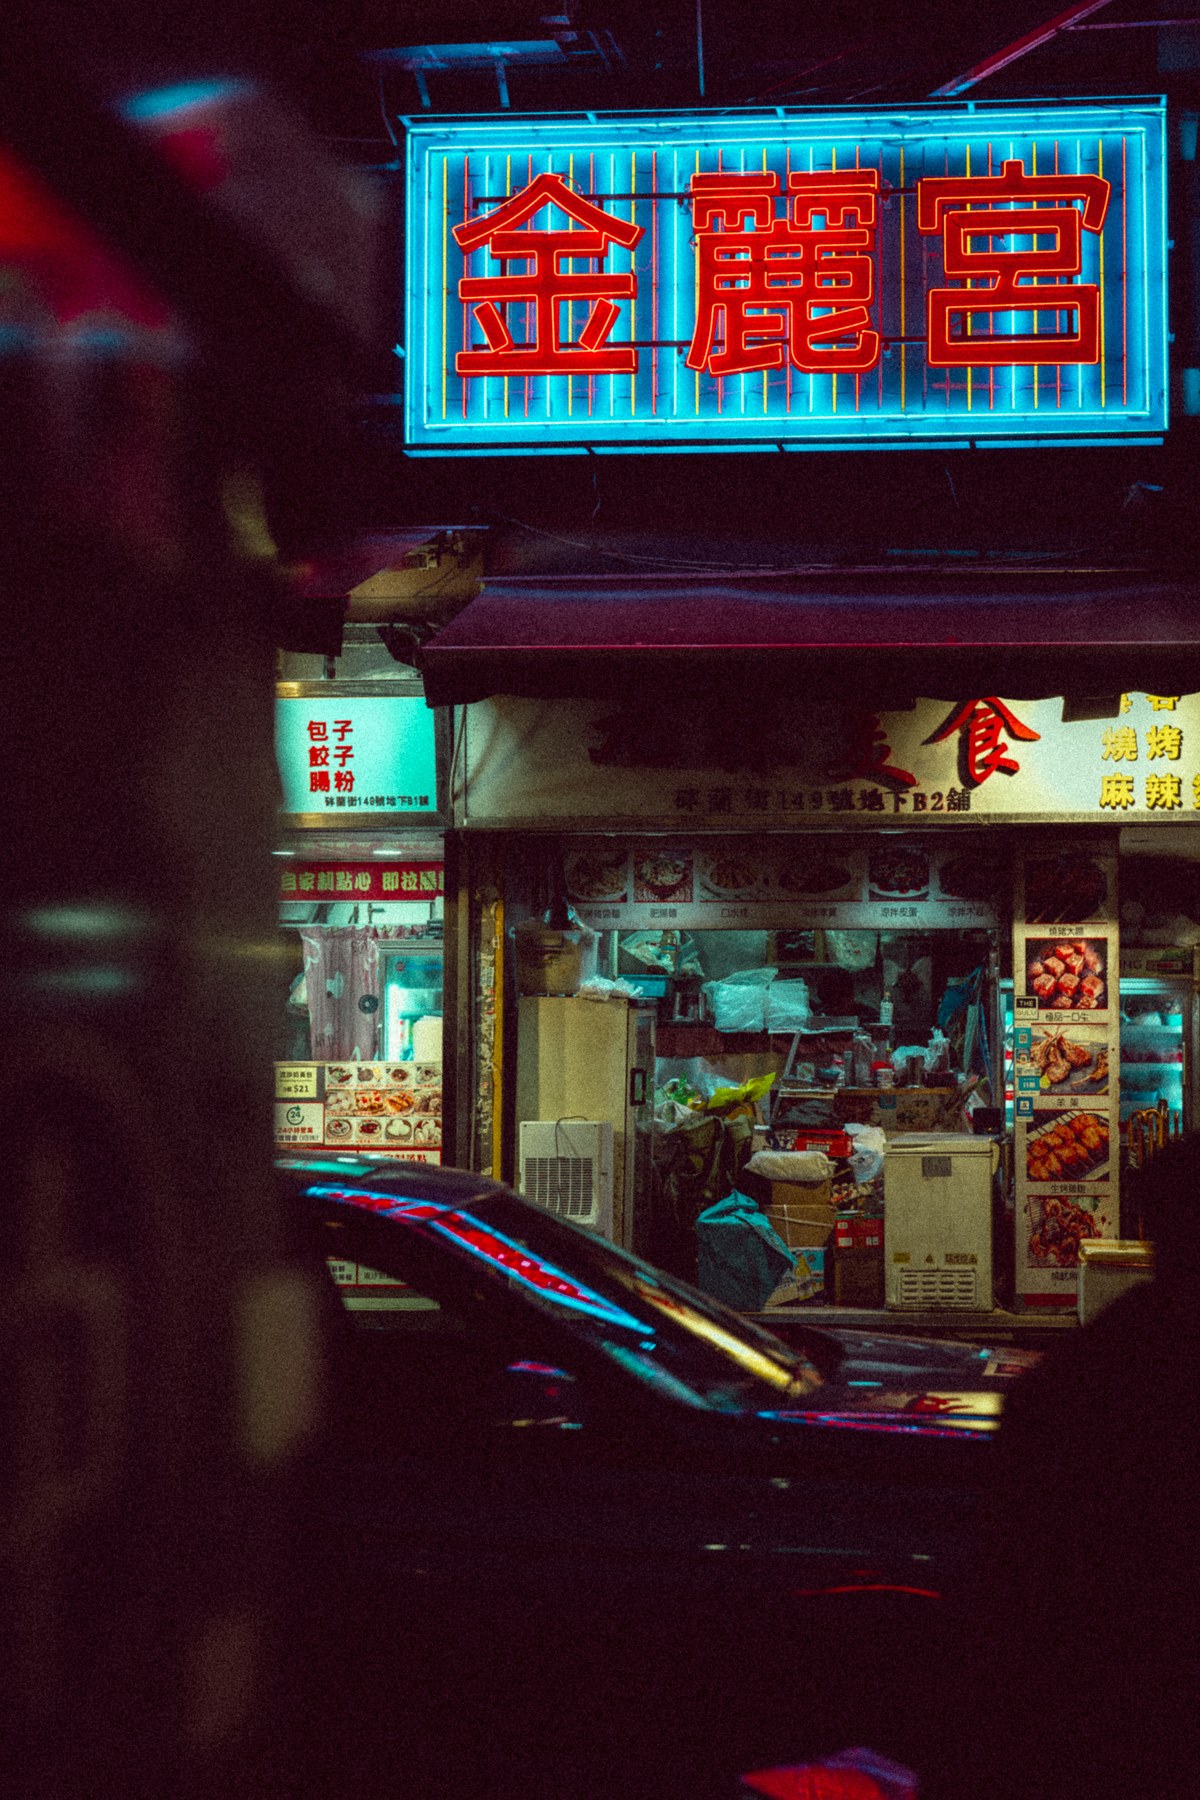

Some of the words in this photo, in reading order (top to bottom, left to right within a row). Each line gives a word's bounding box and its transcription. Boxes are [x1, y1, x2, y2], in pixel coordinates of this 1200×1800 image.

[452, 159, 1110, 378] 金麗宮
[307, 719, 353, 742] 包子
[1101, 725, 1184, 762] 燒烤
[308, 745, 354, 767] 餃子
[309, 771, 355, 792] 腸粉
[1099, 772, 1200, 811] 麻辣
